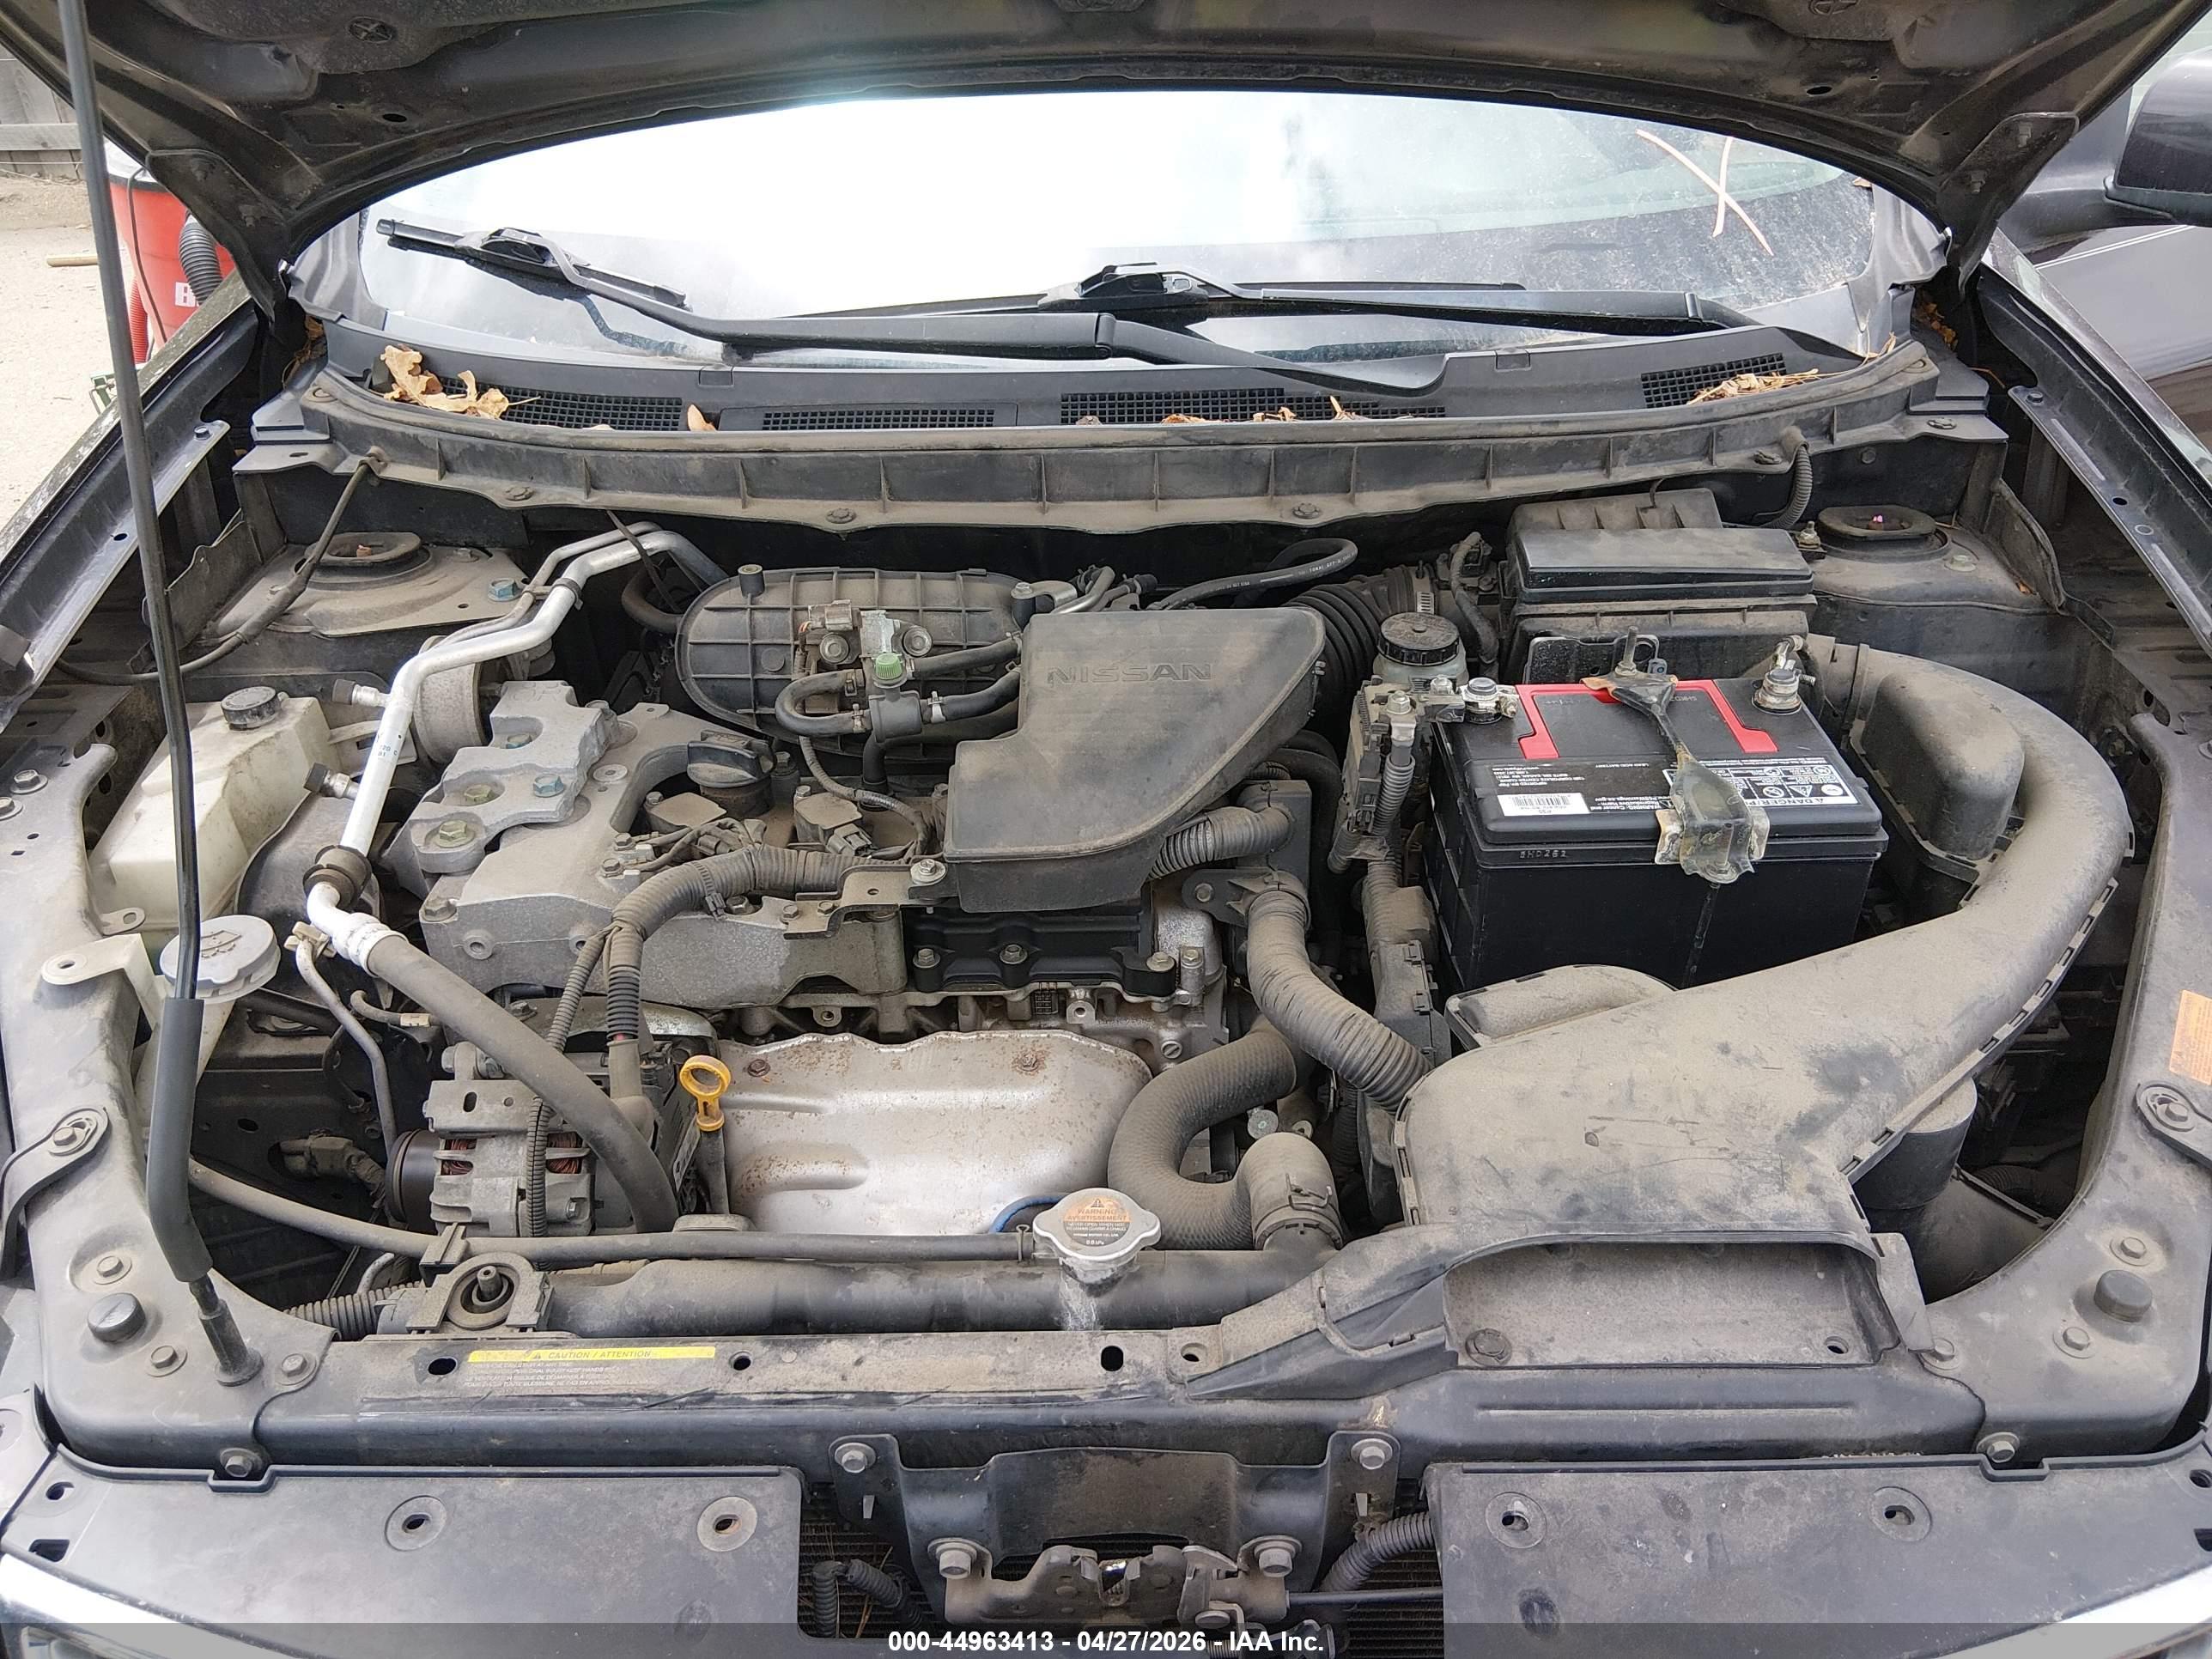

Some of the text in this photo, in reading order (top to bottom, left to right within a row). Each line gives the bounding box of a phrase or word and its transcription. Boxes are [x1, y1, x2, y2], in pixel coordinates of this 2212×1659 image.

[1047, 663, 1212, 684] NISSAN
[548, 1351, 590, 1359] CAUTION
[599, 1350, 652, 1358] ATTENTION
